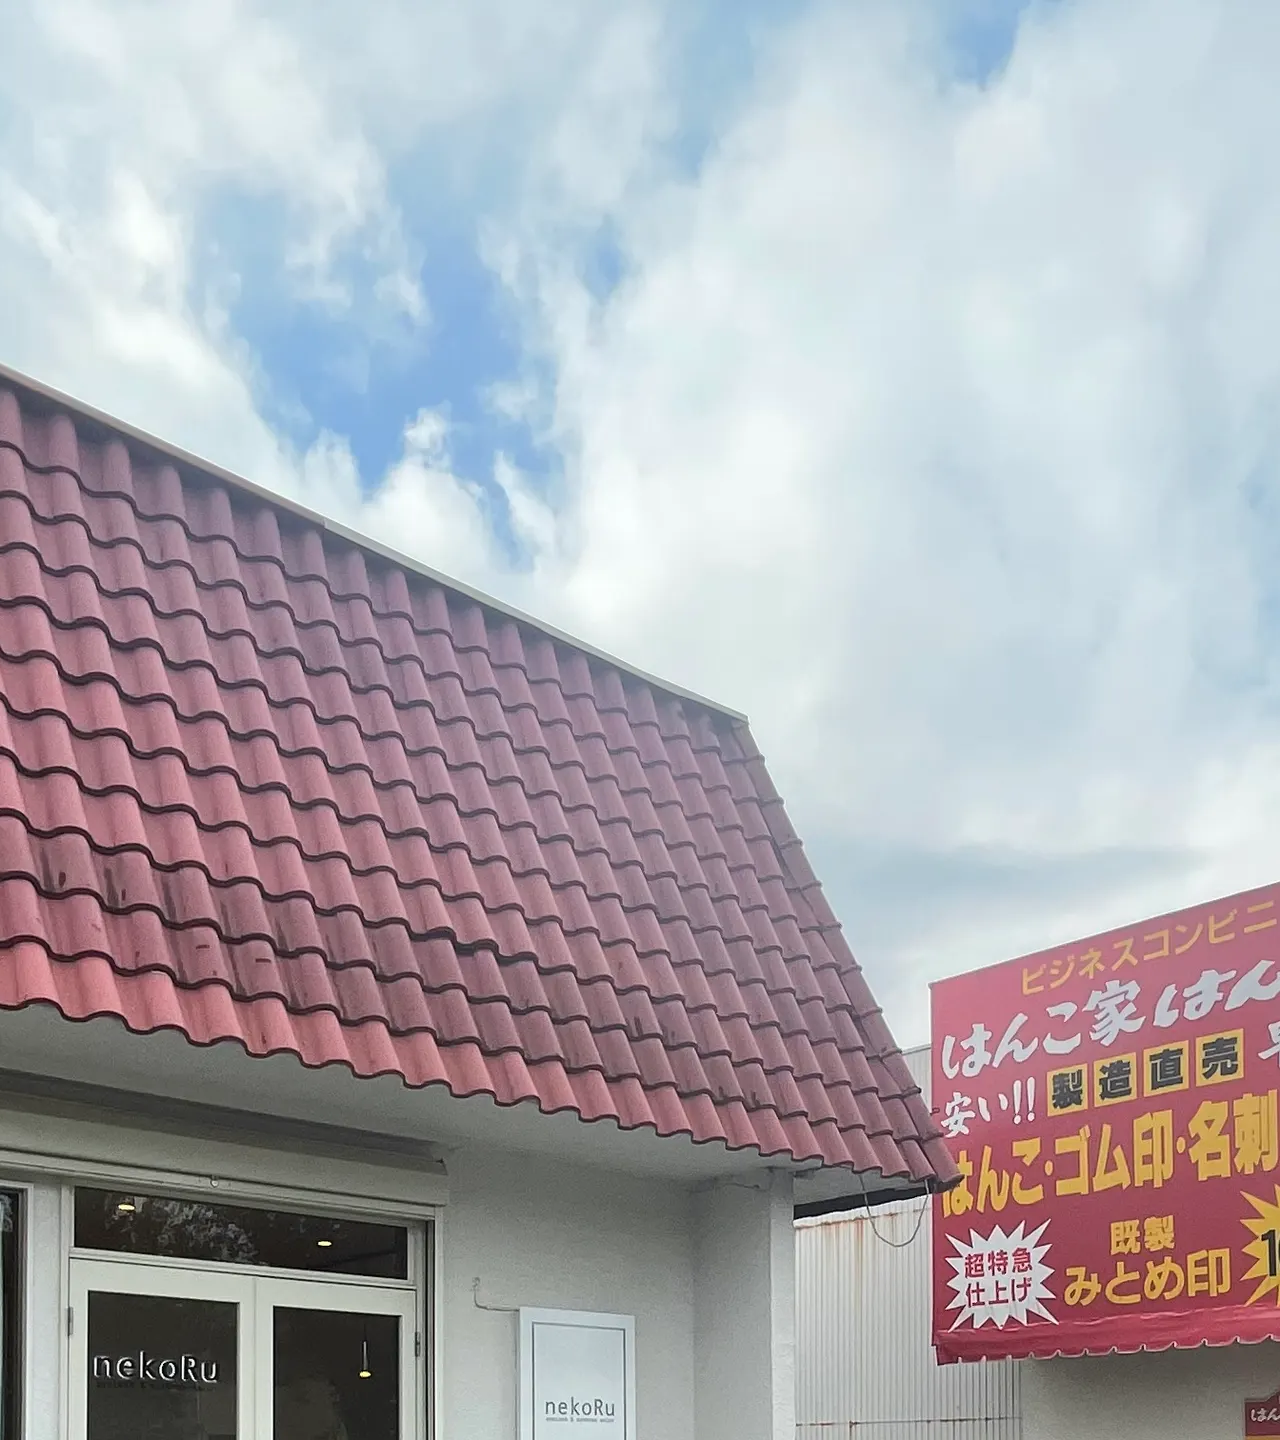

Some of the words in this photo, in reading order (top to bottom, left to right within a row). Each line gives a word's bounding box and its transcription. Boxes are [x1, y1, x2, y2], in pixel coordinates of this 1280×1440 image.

[1022, 900, 1277, 995] ビジネスコンビニ
[1051, 1034, 1240, 1110] 製造直売
[1109, 1214, 1176, 1256] 既製
[963, 1246, 1034, 1280] 超特急
[1063, 1247, 1232, 1307] みとめ印
[964, 1276, 1033, 1309] 仕上げ
[93, 1350, 218, 1384] nekoRu
[545, 1396, 615, 1416] nekoRu
